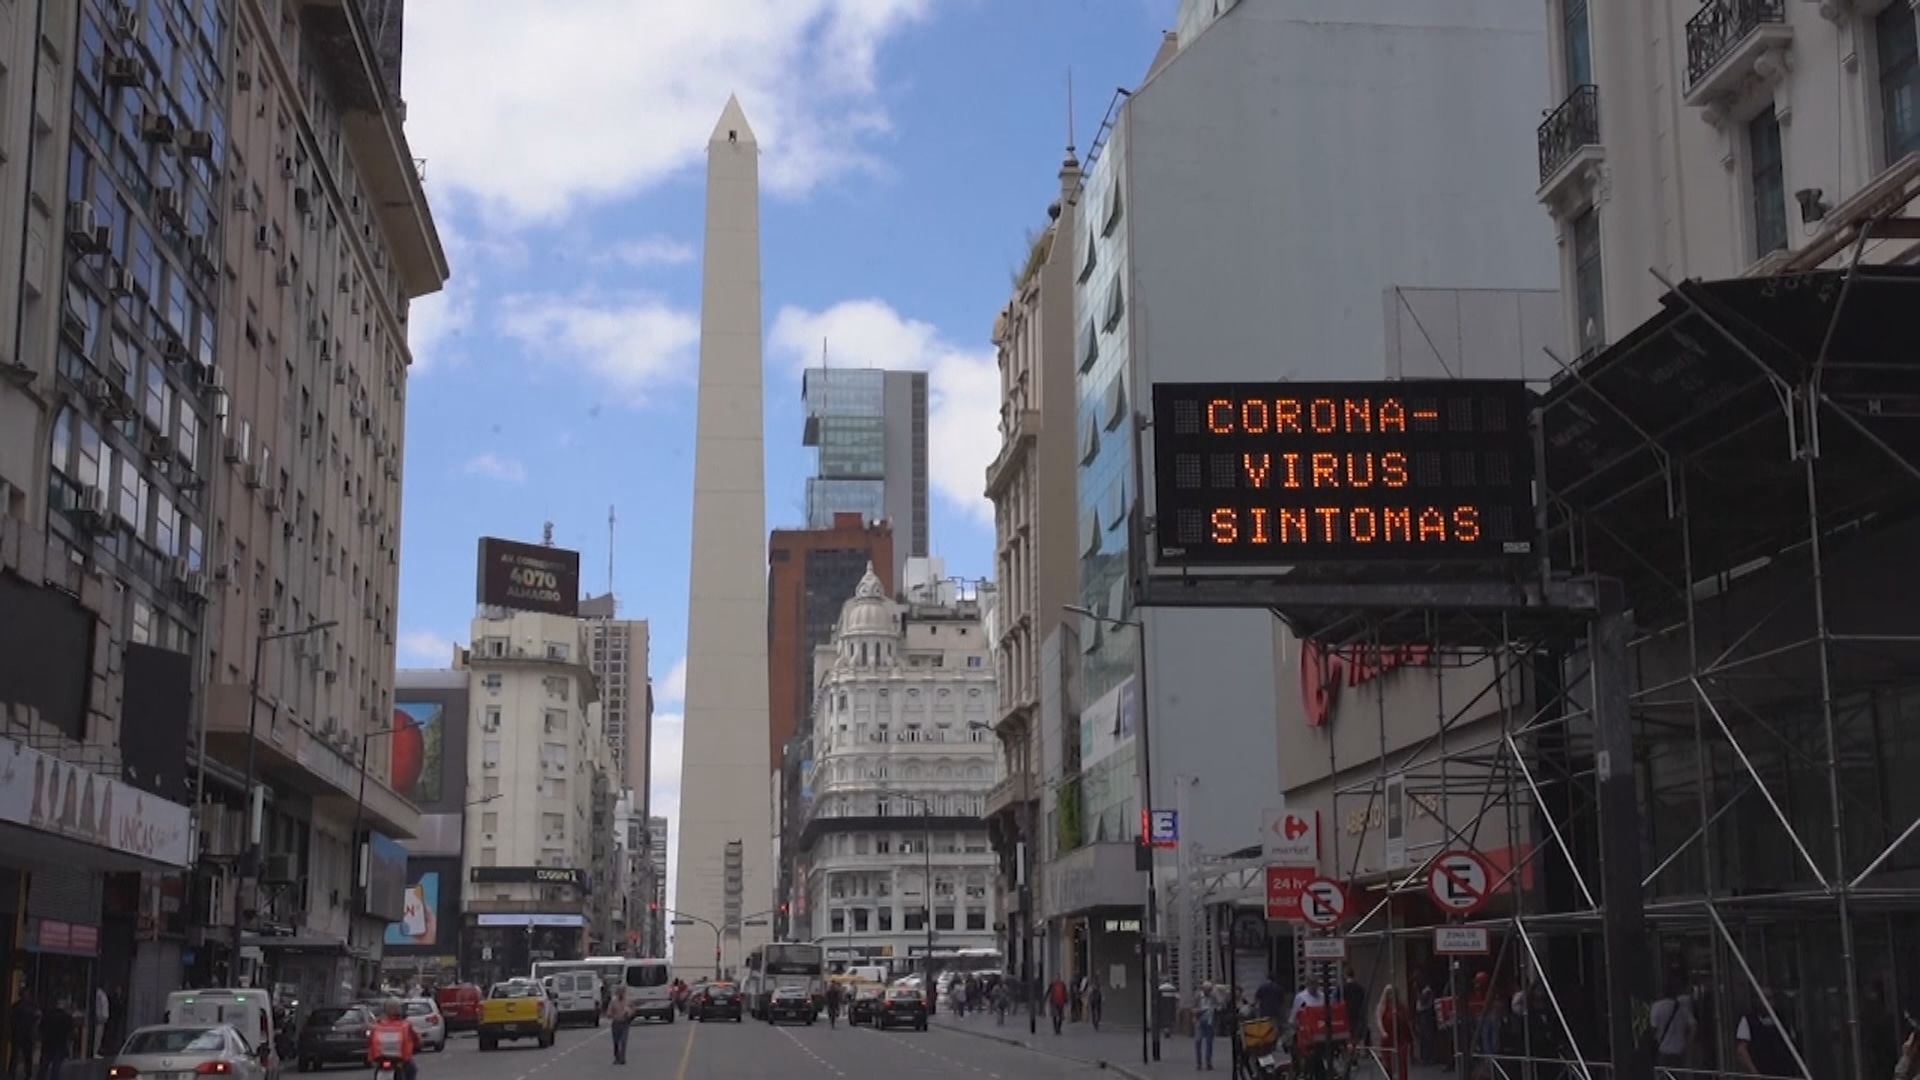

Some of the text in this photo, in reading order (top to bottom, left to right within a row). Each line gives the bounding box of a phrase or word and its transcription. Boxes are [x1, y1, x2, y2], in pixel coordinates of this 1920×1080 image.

[1207, 399, 1438, 433] CORONA-
[1243, 452, 1408, 487] VIRUS
[1211, 506, 1480, 543] SINTOMAS
[510, 567, 557, 589] 4070
[1272, 878, 1290, 889] 24
